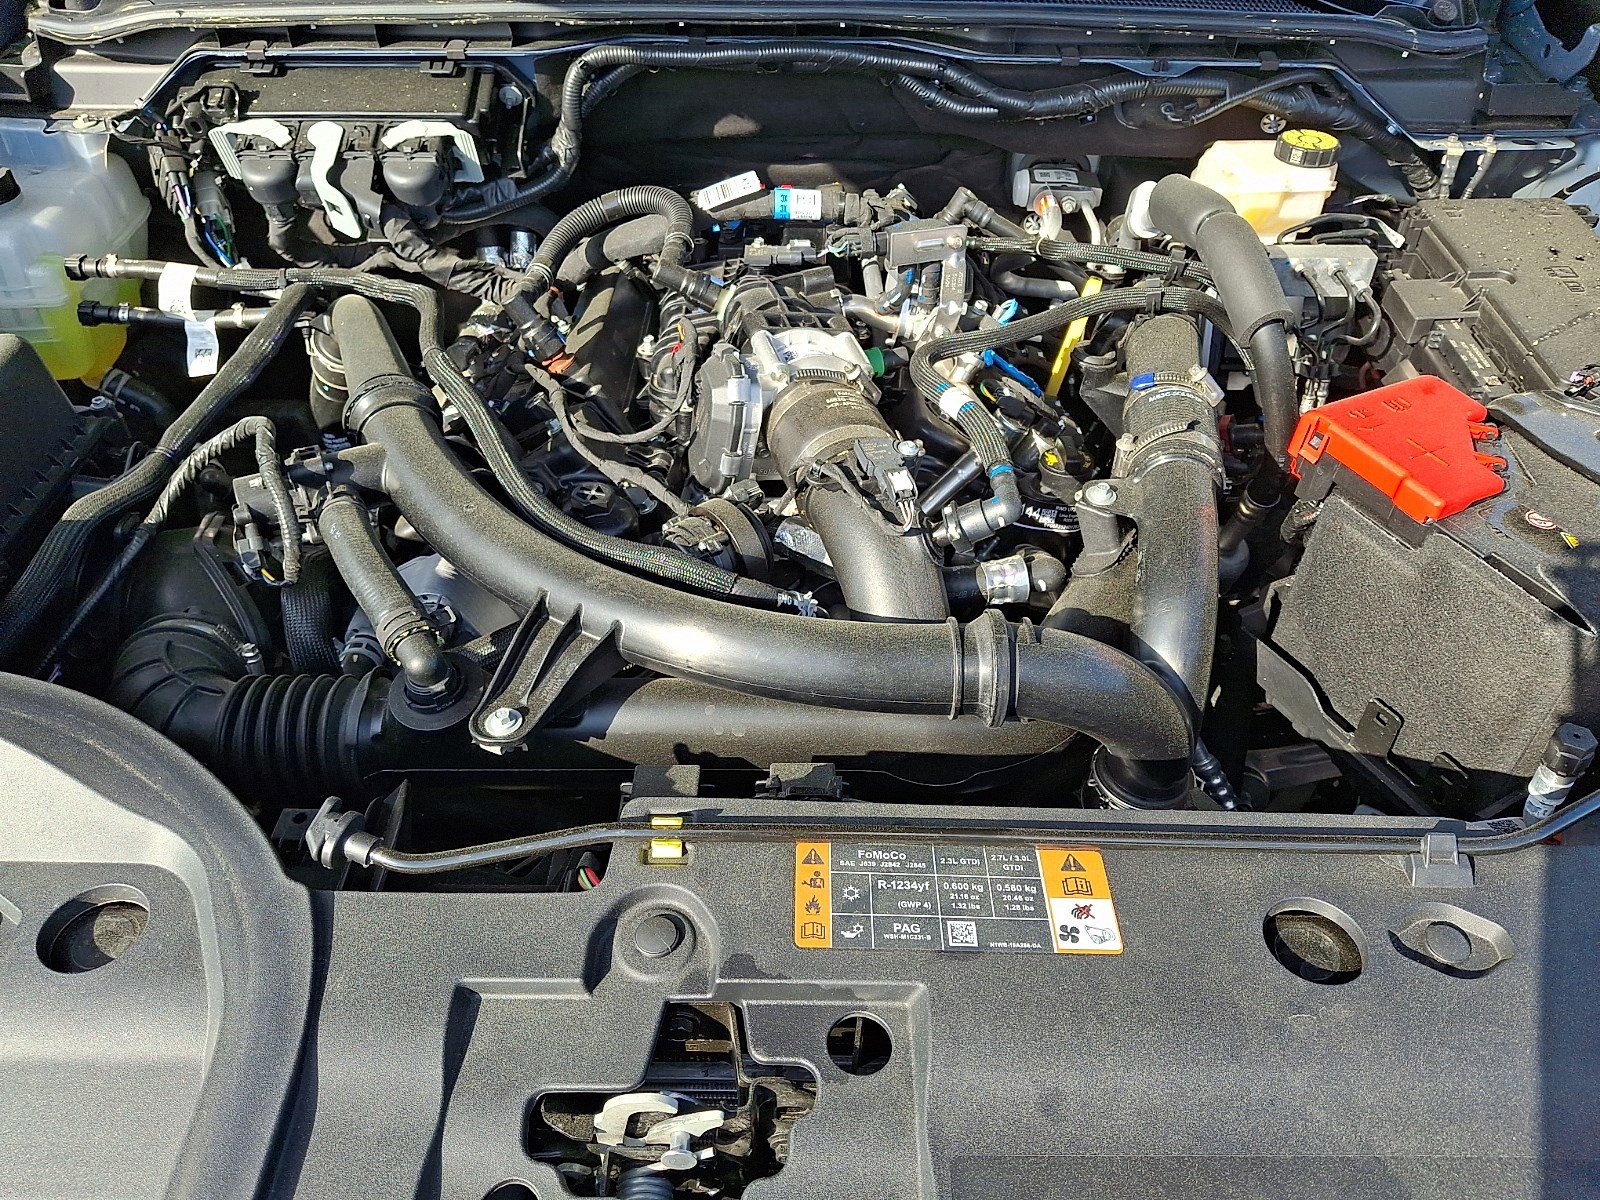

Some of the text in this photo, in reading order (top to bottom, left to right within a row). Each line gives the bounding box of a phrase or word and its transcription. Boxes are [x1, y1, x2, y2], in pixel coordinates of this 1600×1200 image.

[858, 850, 906, 860] FoMoCo
[878, 880, 930, 892] R-1234yf
[943, 882, 984, 892] 0.600 kg
[1024, 884, 1037, 893] kg
[898, 901, 931, 910] (GWP 4)
[894, 922, 920, 933] PAG
